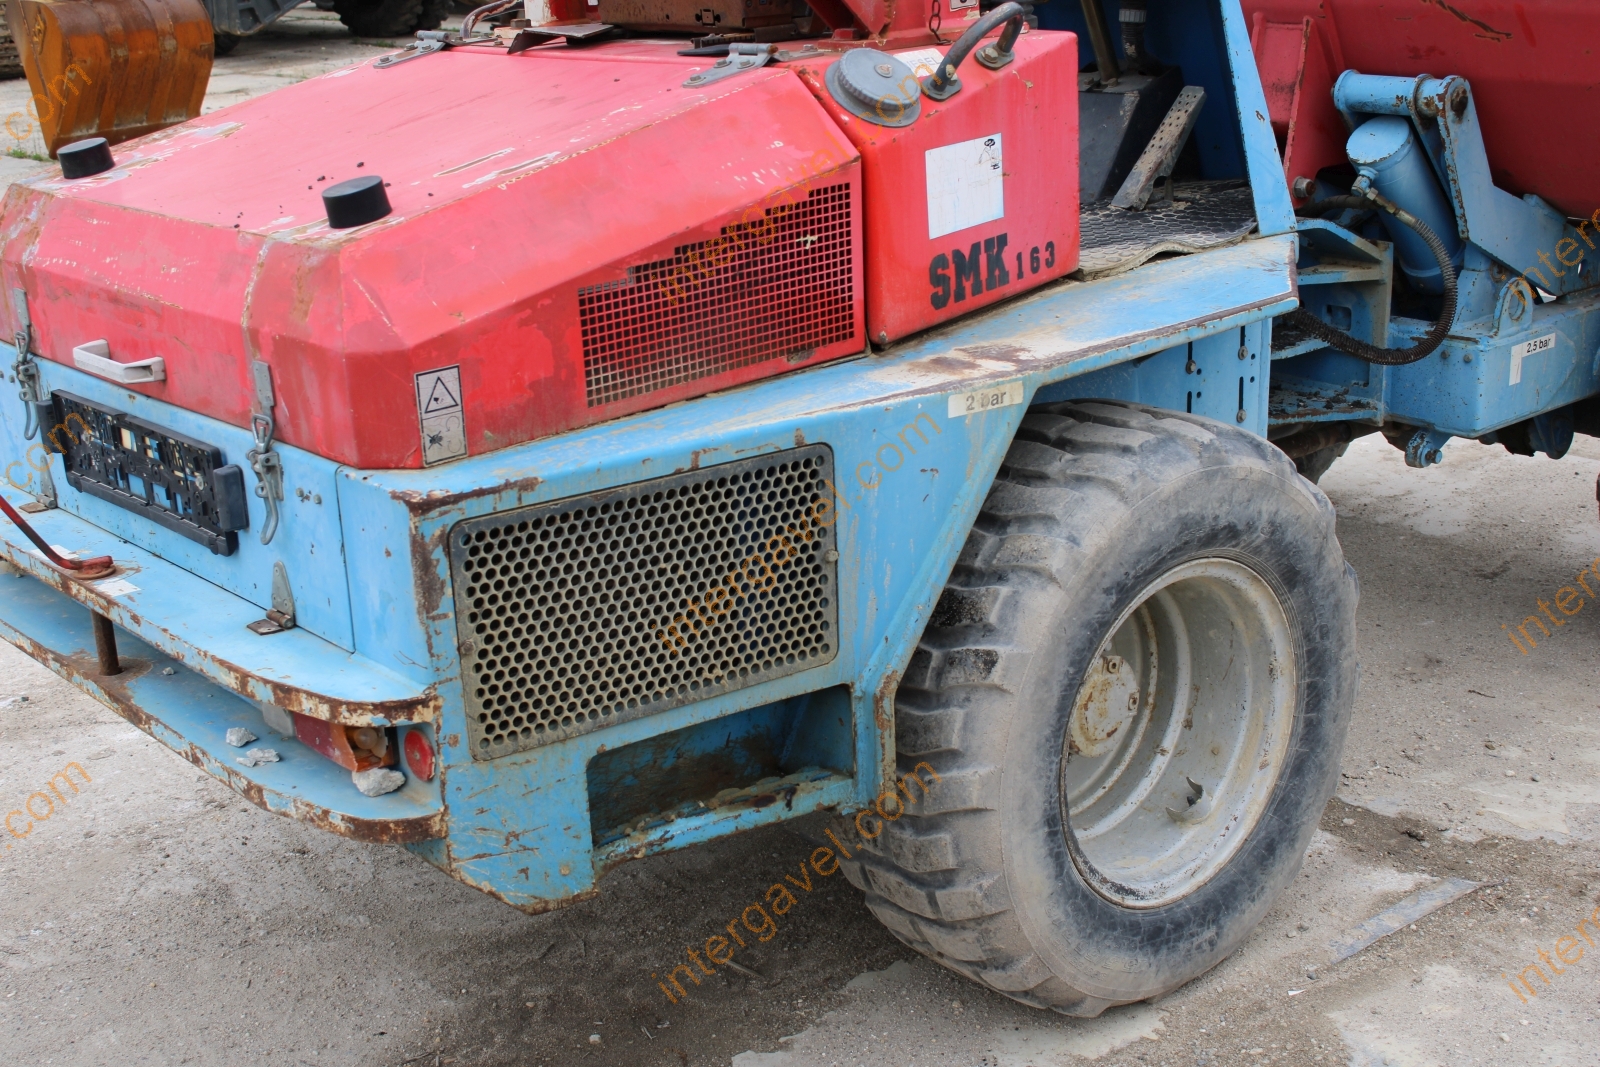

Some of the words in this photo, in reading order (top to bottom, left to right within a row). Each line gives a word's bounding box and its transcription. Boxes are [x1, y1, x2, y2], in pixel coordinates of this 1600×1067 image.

[906, 56, 940, 70] IESEL
[929, 232, 1010, 310] SMK
[1016, 241, 1056, 280] 163
[1538, 338, 1551, 349] bar
[966, 394, 975, 411] 2
[980, 391, 1007, 408] bar
